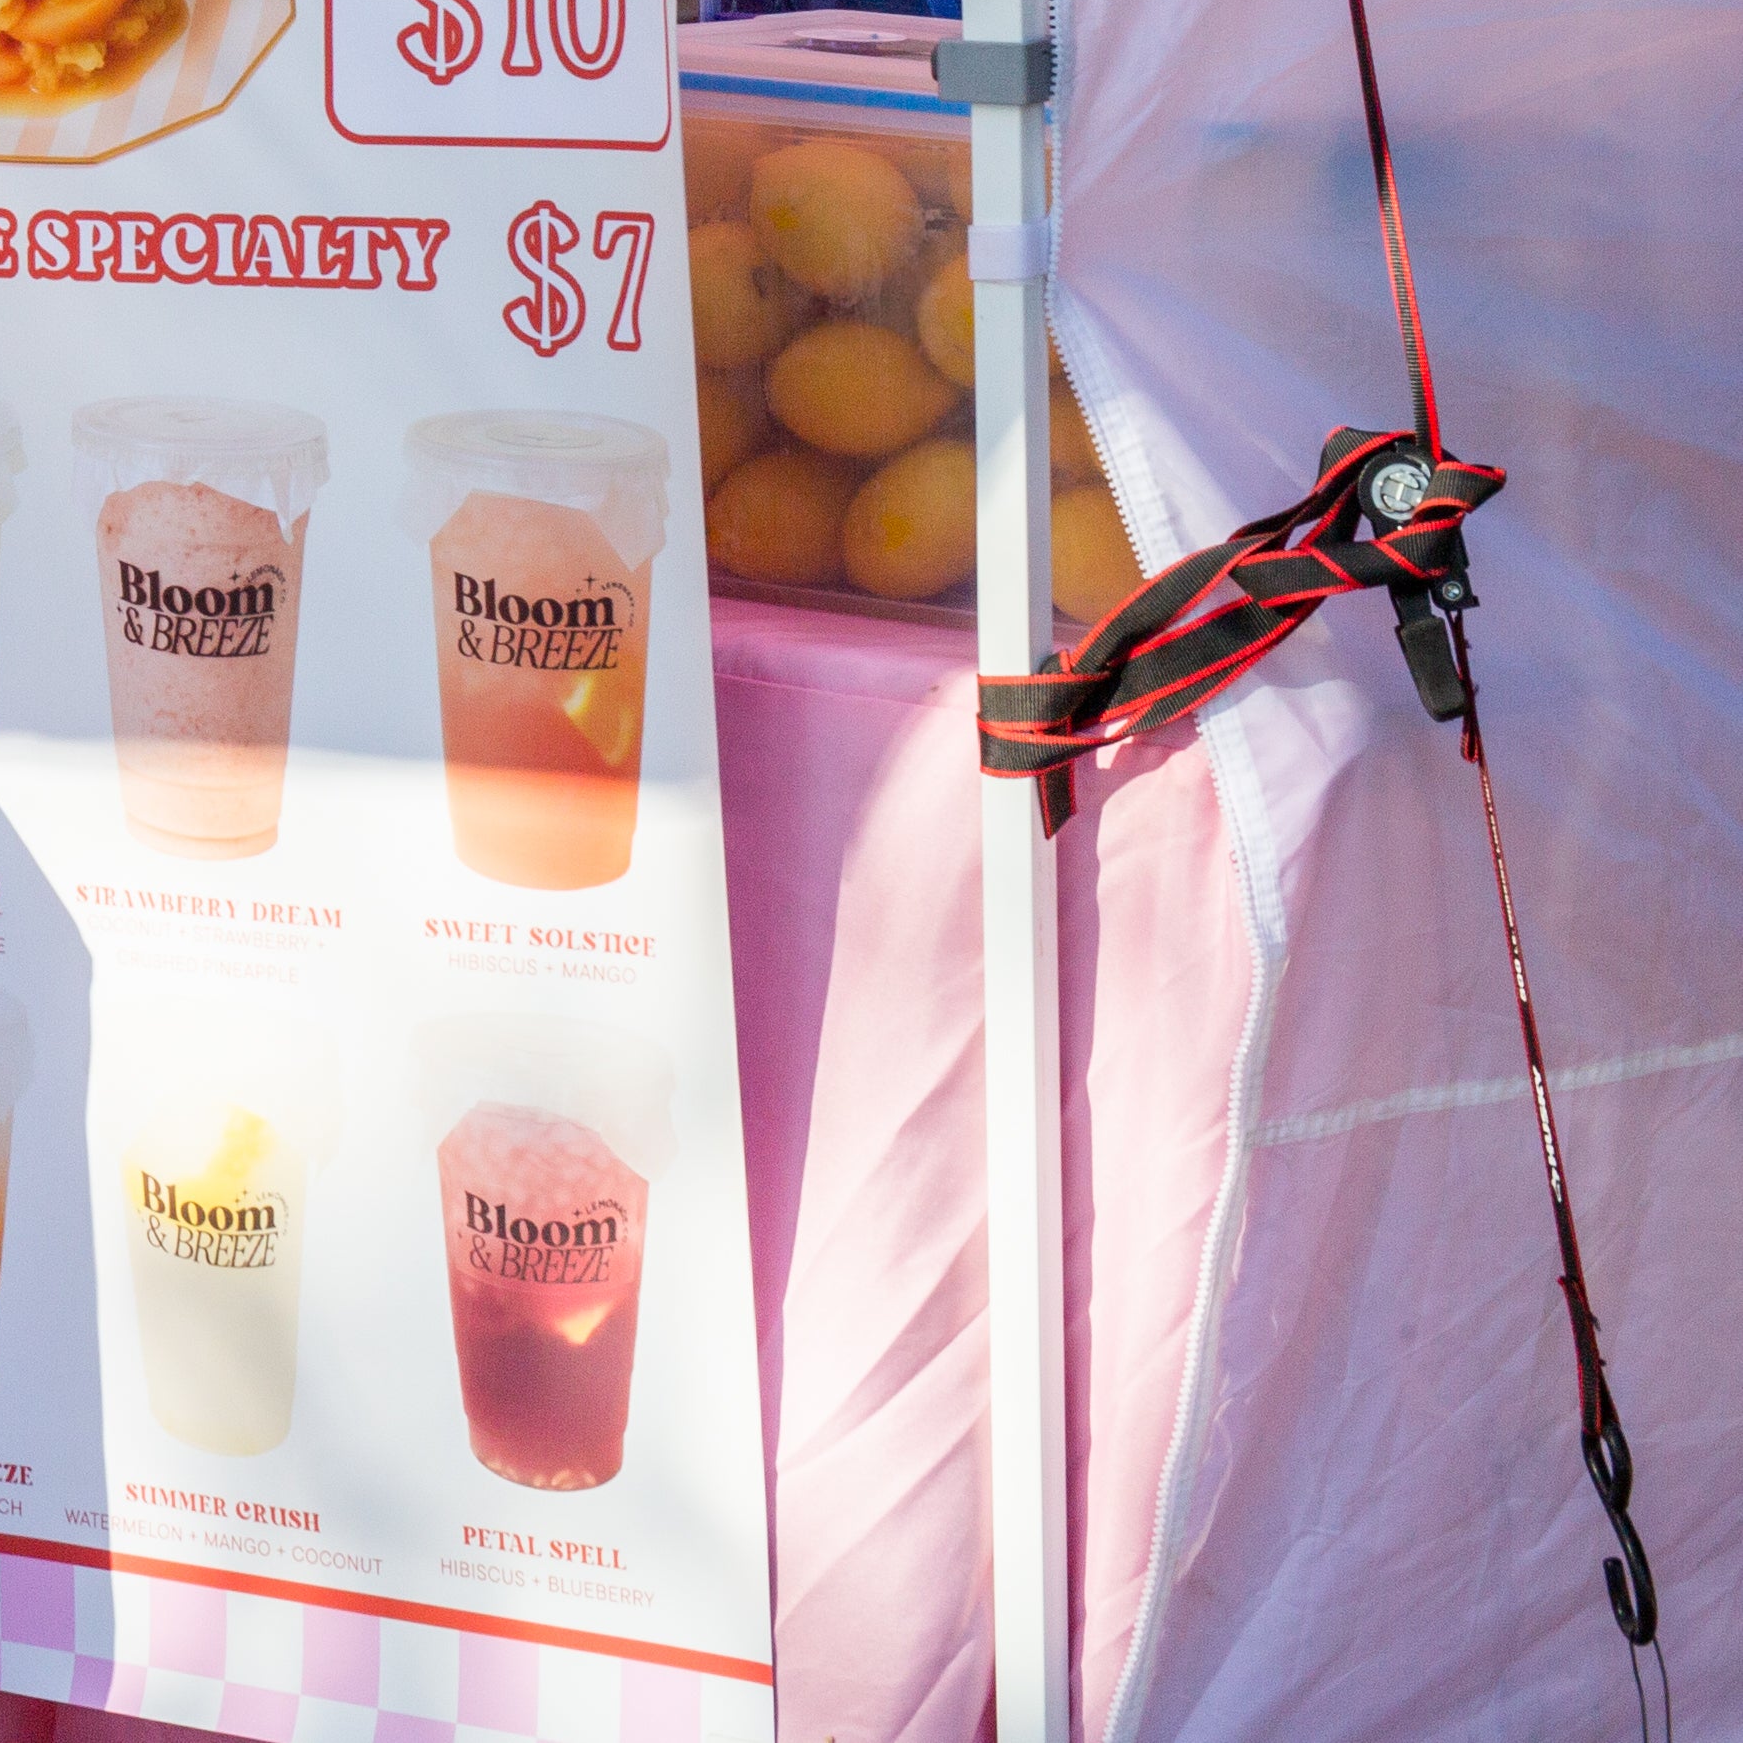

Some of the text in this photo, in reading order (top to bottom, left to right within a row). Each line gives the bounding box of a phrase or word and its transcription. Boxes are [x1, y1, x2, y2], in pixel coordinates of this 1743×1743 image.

[27, 209, 450, 292] SPECIALTY
[503, 200, 656, 358] $7
[118, 560, 276, 617] Bloom
[454, 571, 616, 628] Bloom
[123, 606, 275, 658] & BREEZE
[457, 619, 624, 670] & BREEZE
[76, 884, 343, 929] STRAWBERRY DREAM
[193, 925, 311, 952] STRAWBERRY
[425, 918, 657, 958] SWEET SOLSTICE
[448, 952, 538, 976] HIBISCUS
[562, 961, 637, 985] MANGO
[141, 1170, 277, 1232] Bloom
[464, 1190, 617, 1248] Bloom
[146, 1214, 279, 1268] & BREEZE
[469, 1234, 615, 1284] & BREEZE
[125, 1482, 323, 1533] SUMMER CRUSH
[65, 1509, 184, 1542] WATERMELON
[204, 1530, 272, 1557] MANGO
[292, 1545, 384, 1576] COCONUT
[462, 1525, 628, 1571] PETAL SPELL
[440, 1557, 526, 1588] HIBISCUS
[548, 1575, 656, 1607] BLUEBERRY
